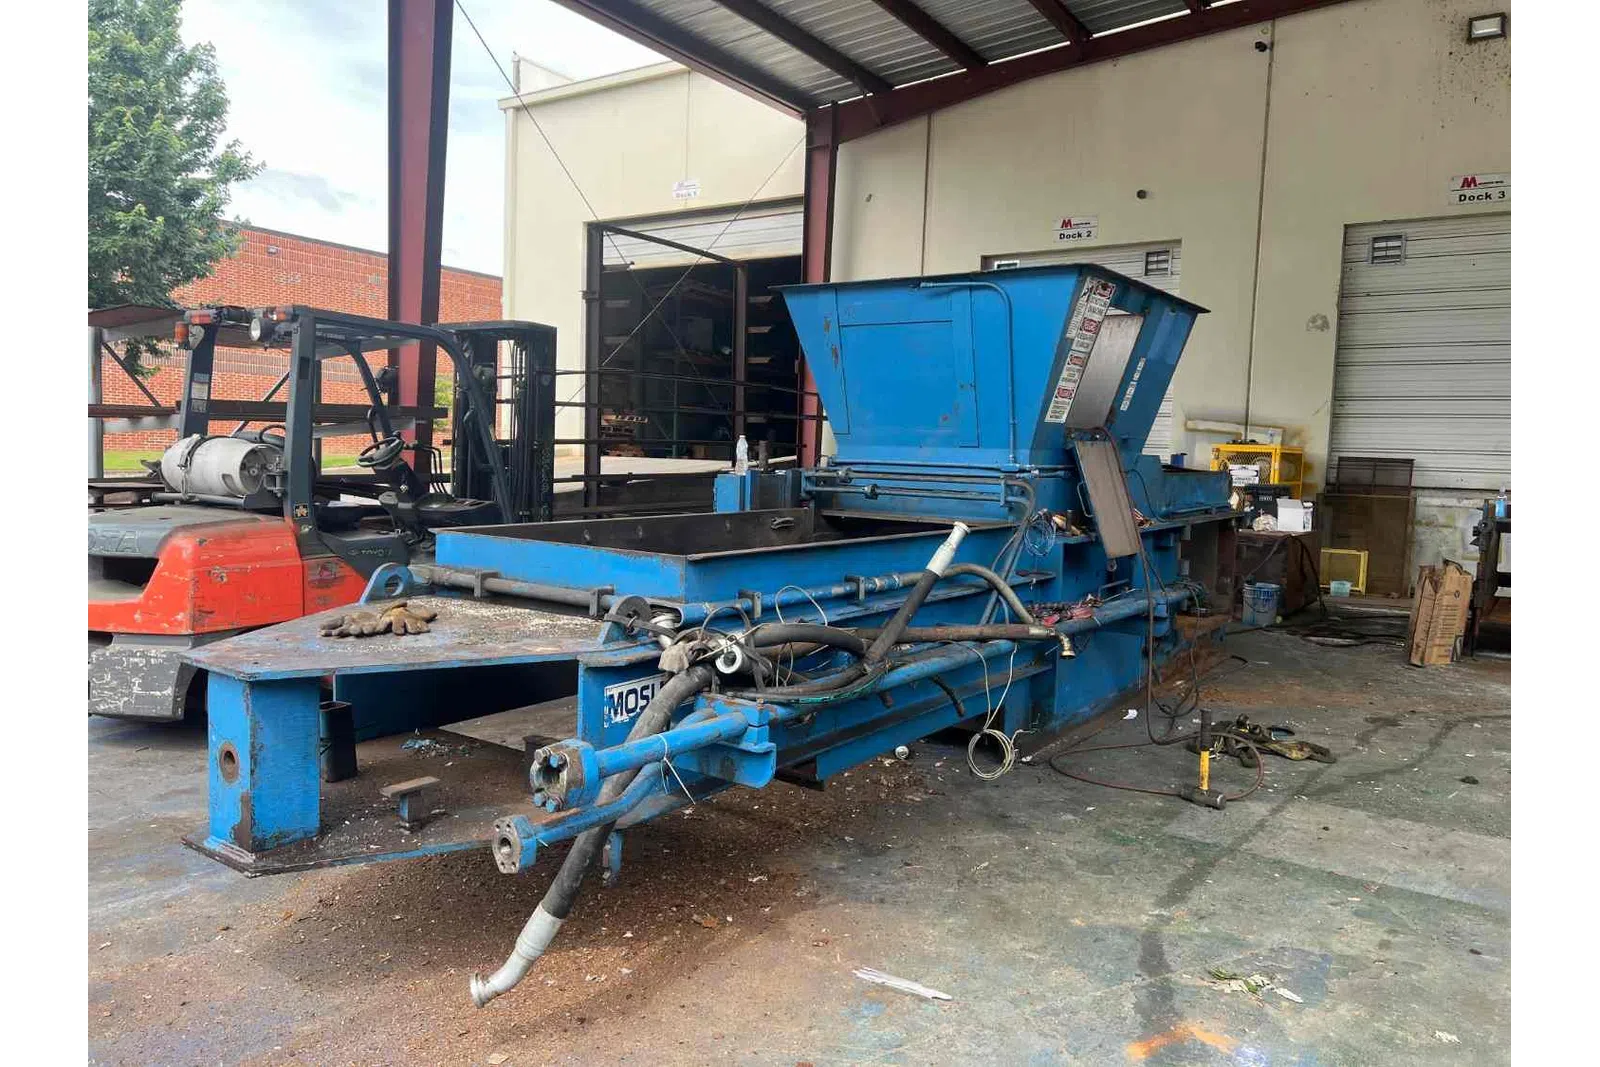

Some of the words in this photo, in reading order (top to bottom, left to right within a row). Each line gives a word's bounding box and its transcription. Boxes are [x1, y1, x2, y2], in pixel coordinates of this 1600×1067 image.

[1458, 191, 1493, 202] Dock
[1497, 190, 1506, 199] 3
[1059, 231, 1082, 240] Dock
